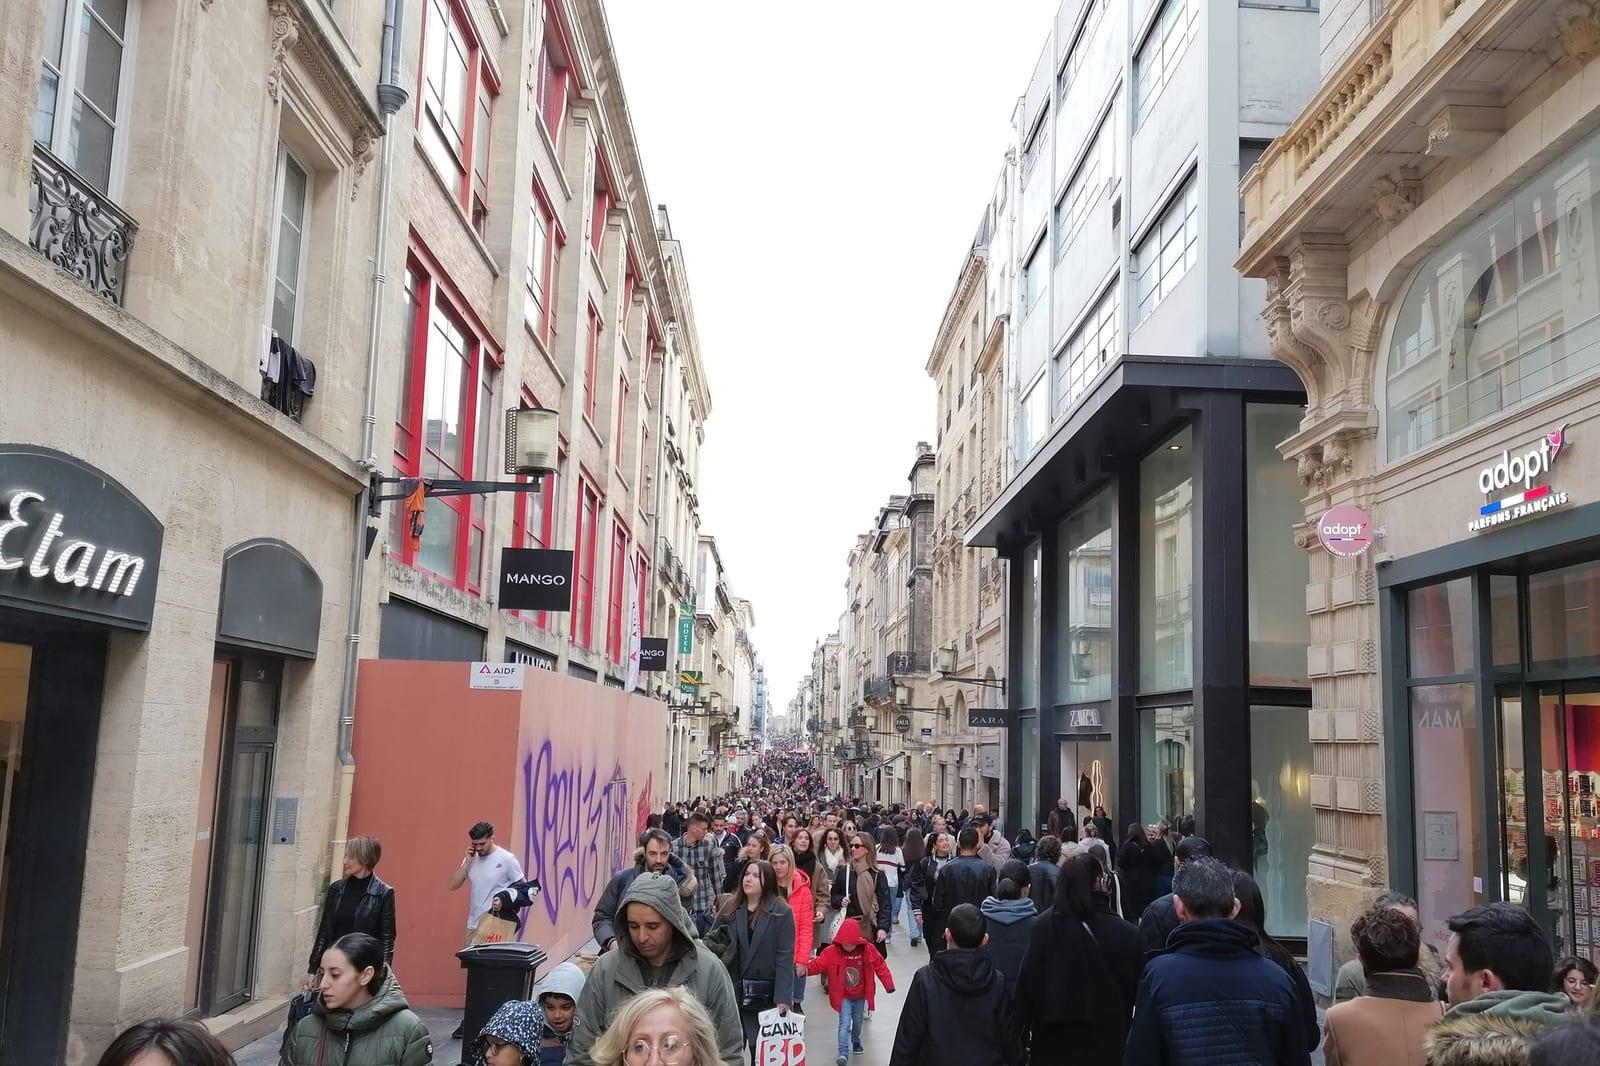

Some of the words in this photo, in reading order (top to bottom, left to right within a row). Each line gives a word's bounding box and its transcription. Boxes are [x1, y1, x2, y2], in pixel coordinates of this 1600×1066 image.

[1479, 438, 1550, 494] adopt
[1468, 510, 1512, 532] PARFUMS
[1513, 492, 1568, 519] FRANÇAIS
[1323, 522, 1362, 538] adopt
[0, 490, 145, 597] Etam
[506, 572, 566, 586] MANGO
[640, 649, 665, 658] ANGO
[493, 667, 516, 675] AIDF
[761, 1022, 802, 1037] CANA
